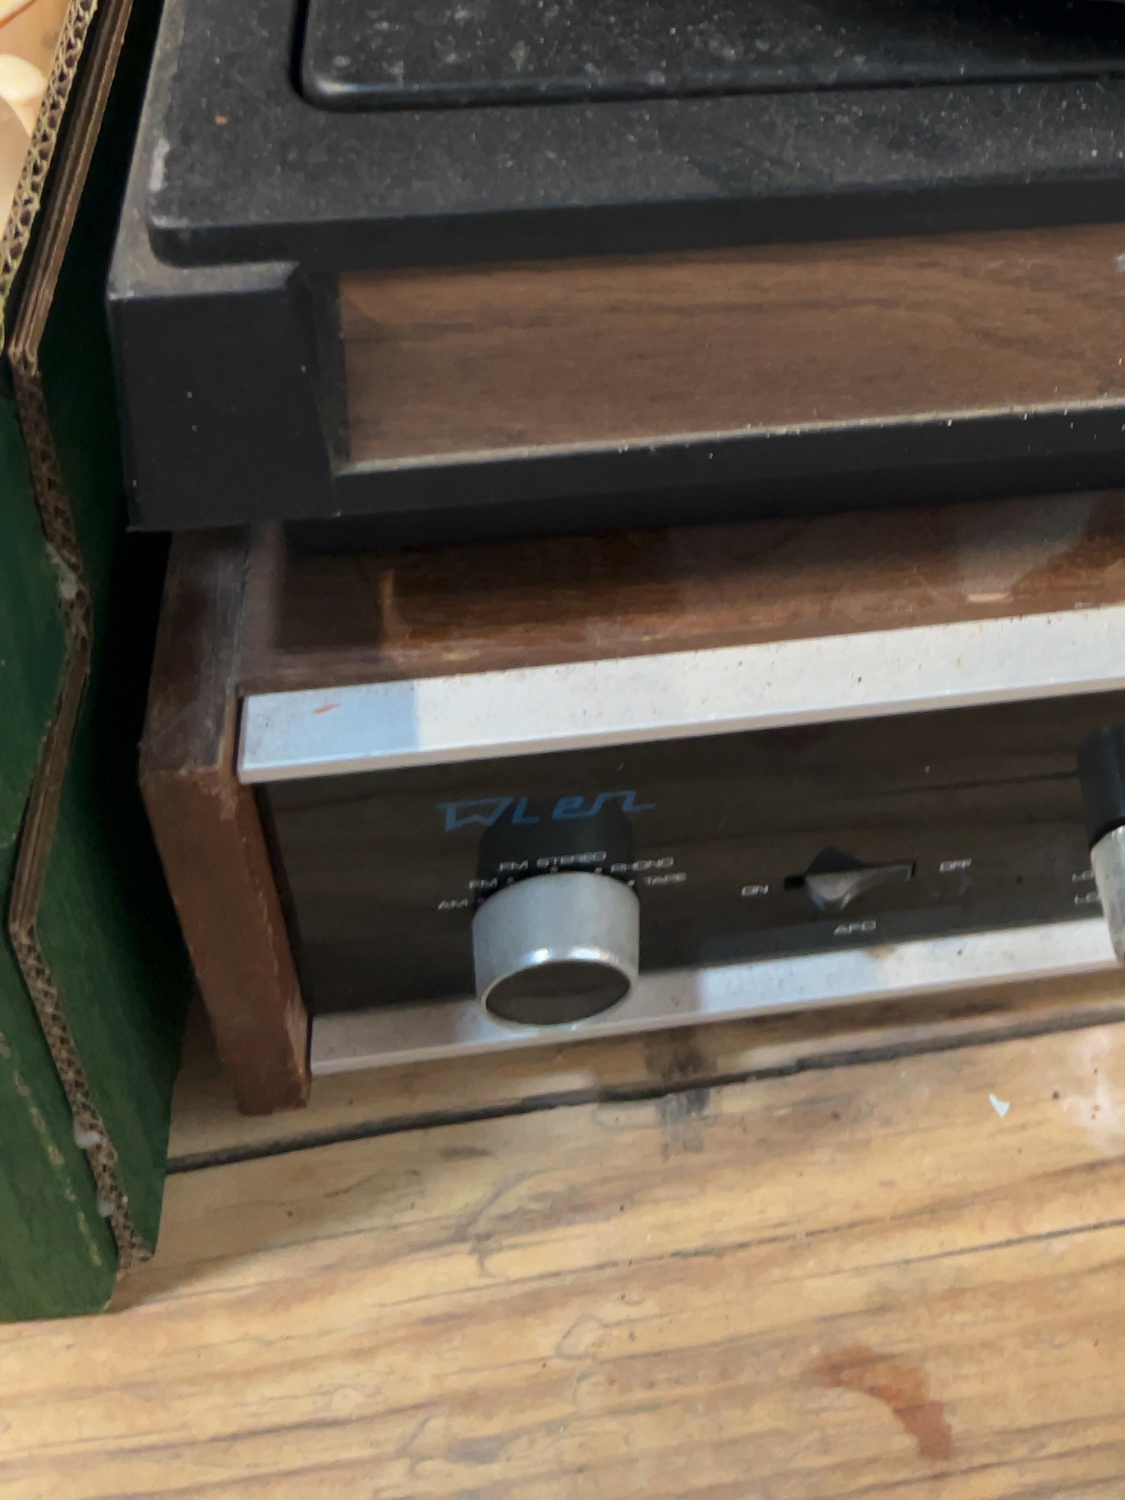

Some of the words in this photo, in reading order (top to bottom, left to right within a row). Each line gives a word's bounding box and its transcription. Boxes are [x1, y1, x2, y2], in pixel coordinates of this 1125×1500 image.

[499, 859, 529, 872] FM
[536, 851, 607, 868] STEREO
[610, 857, 674, 873] PHONO
[938, 858, 973, 873] OFF
[468, 877, 498, 890] FM
[643, 872, 687, 886] TAPE
[740, 884, 769, 897] ON
[437, 898, 469, 910] AM
